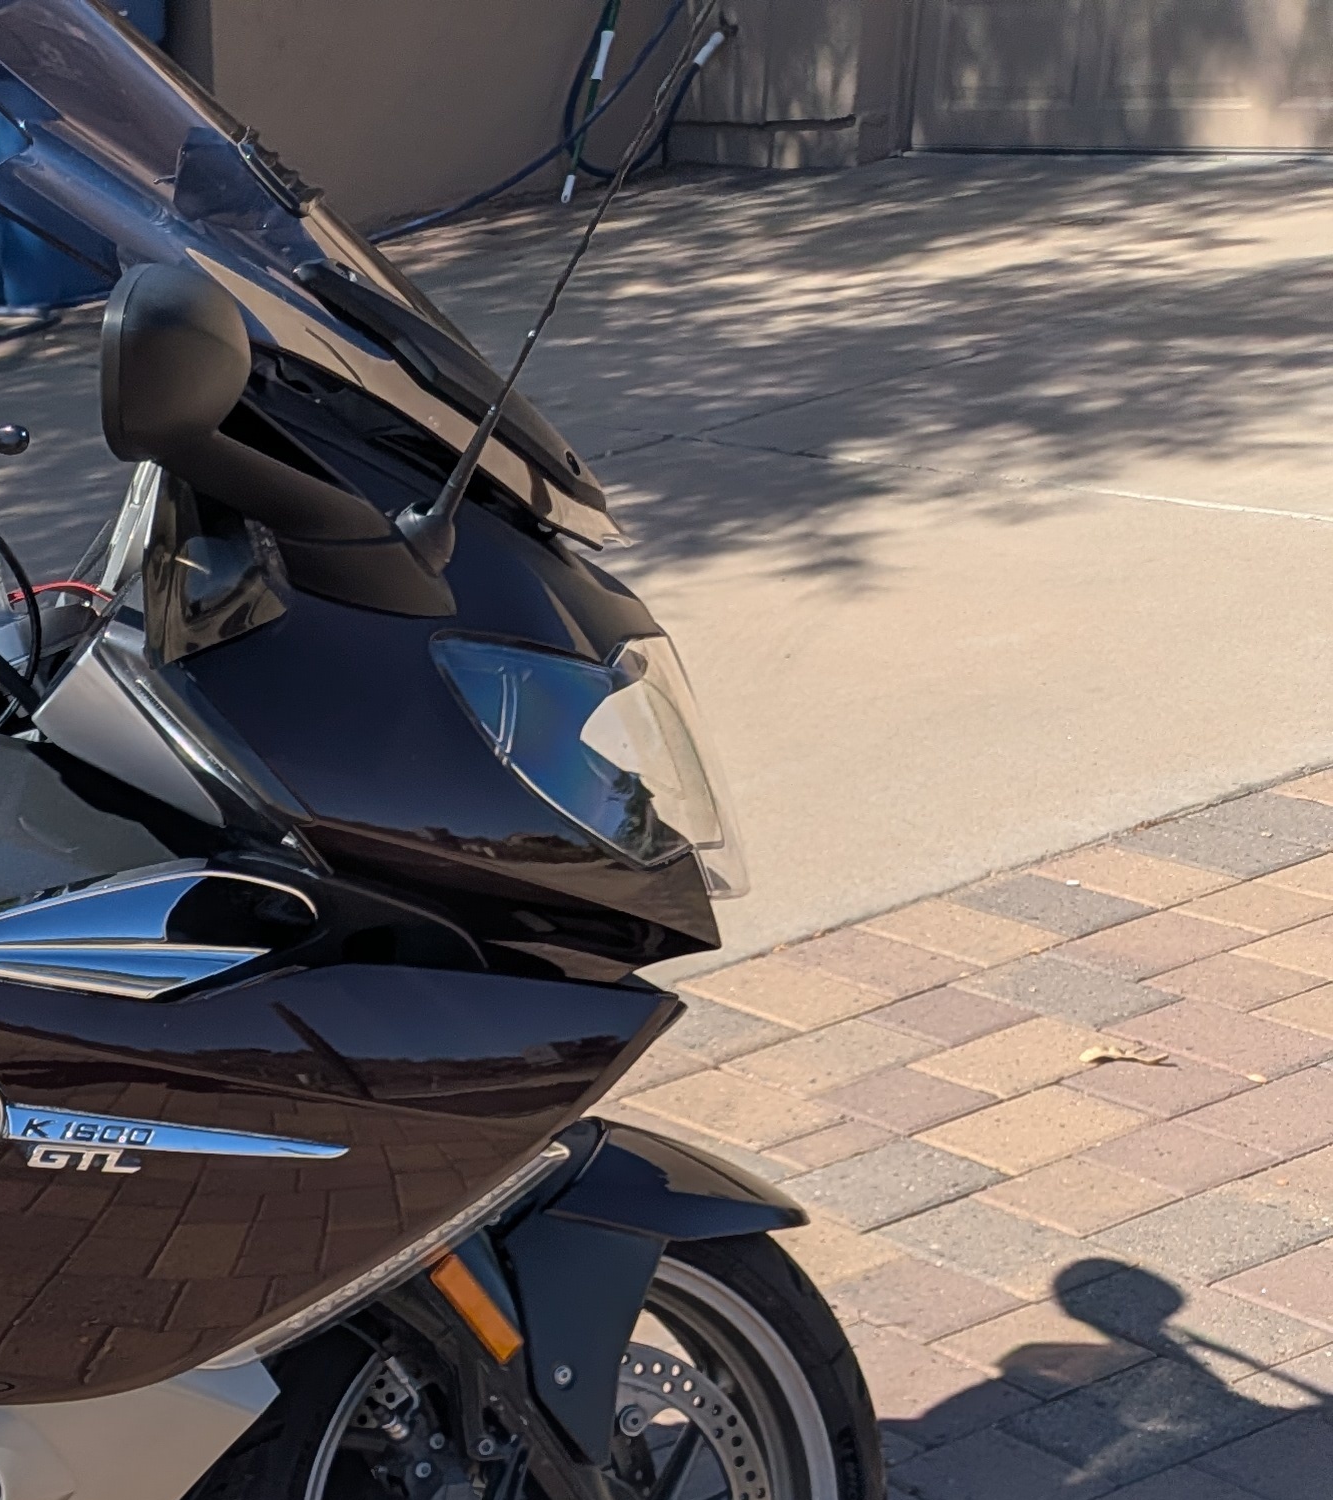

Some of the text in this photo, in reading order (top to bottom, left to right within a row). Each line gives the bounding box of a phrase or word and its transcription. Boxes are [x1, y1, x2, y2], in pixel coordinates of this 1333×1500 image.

[22, 1117, 155, 1146] K 1600
[26, 1144, 142, 1174] GTL
